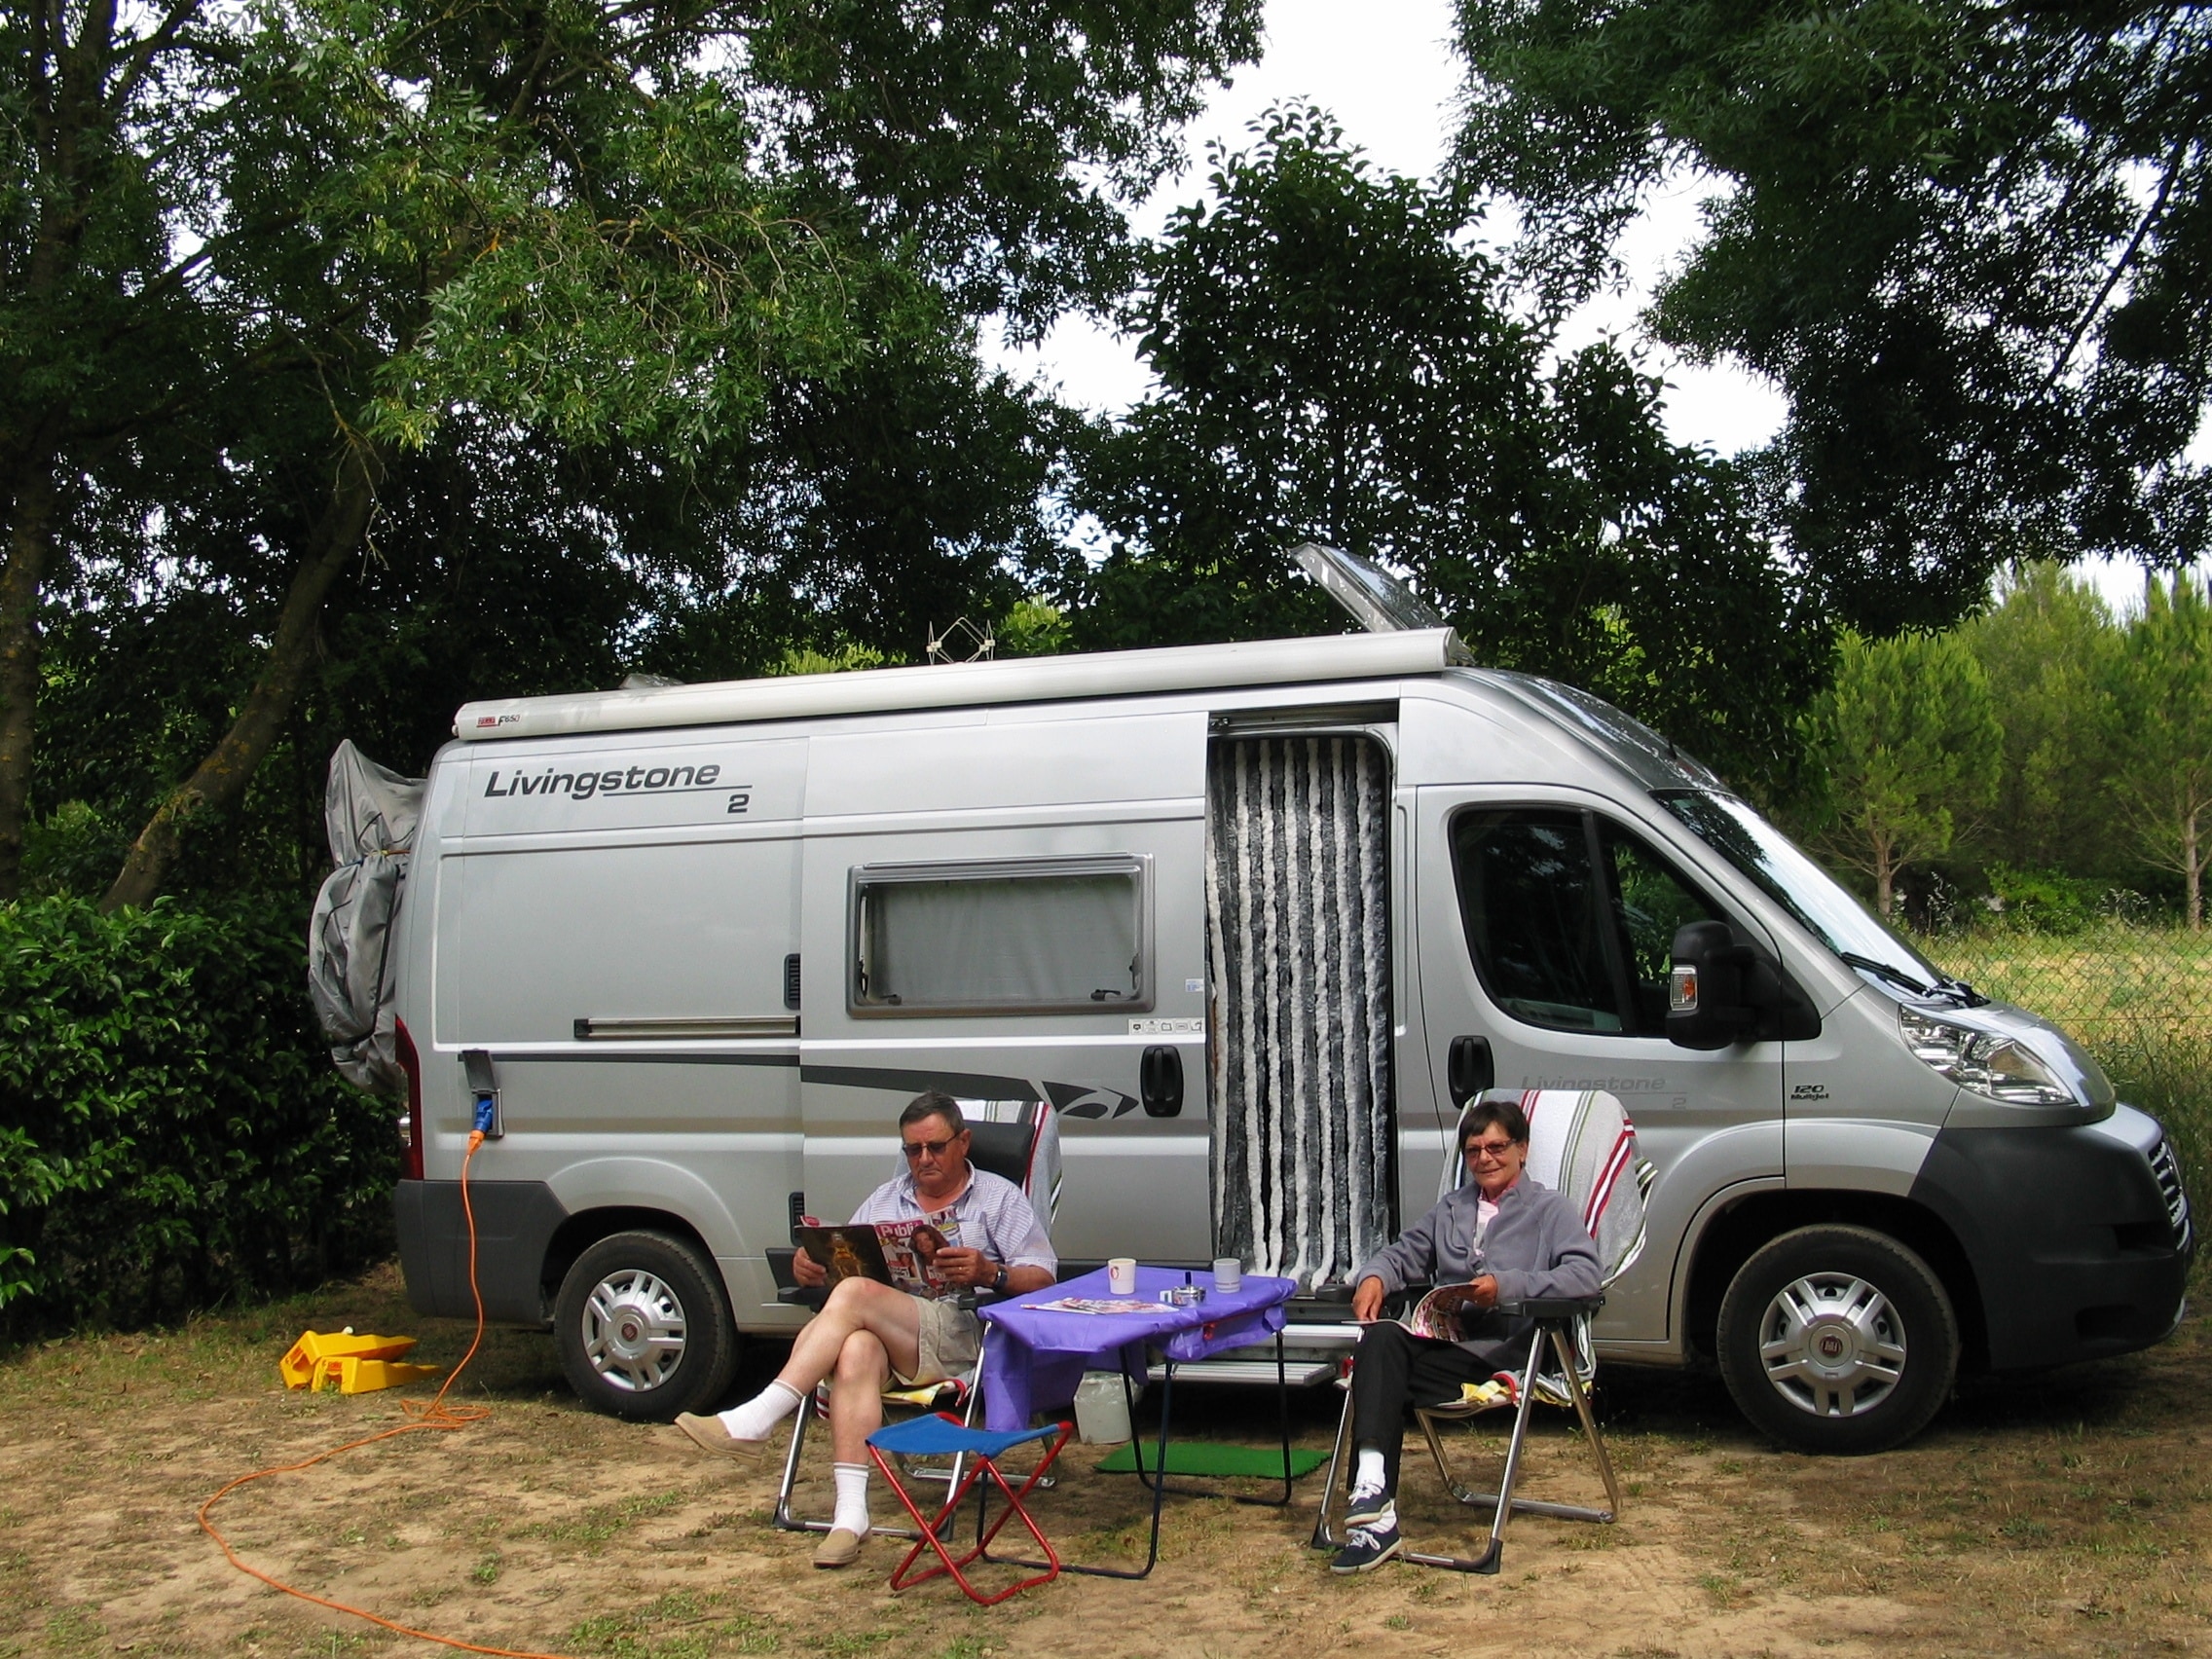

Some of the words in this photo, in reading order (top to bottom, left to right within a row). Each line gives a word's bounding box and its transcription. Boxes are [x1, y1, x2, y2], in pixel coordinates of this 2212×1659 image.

[484, 764, 720, 800] Livingstone
[727, 793, 750, 814] 2
[1794, 1085, 1825, 1093] 120
[1672, 1097, 1687, 1109] 2
